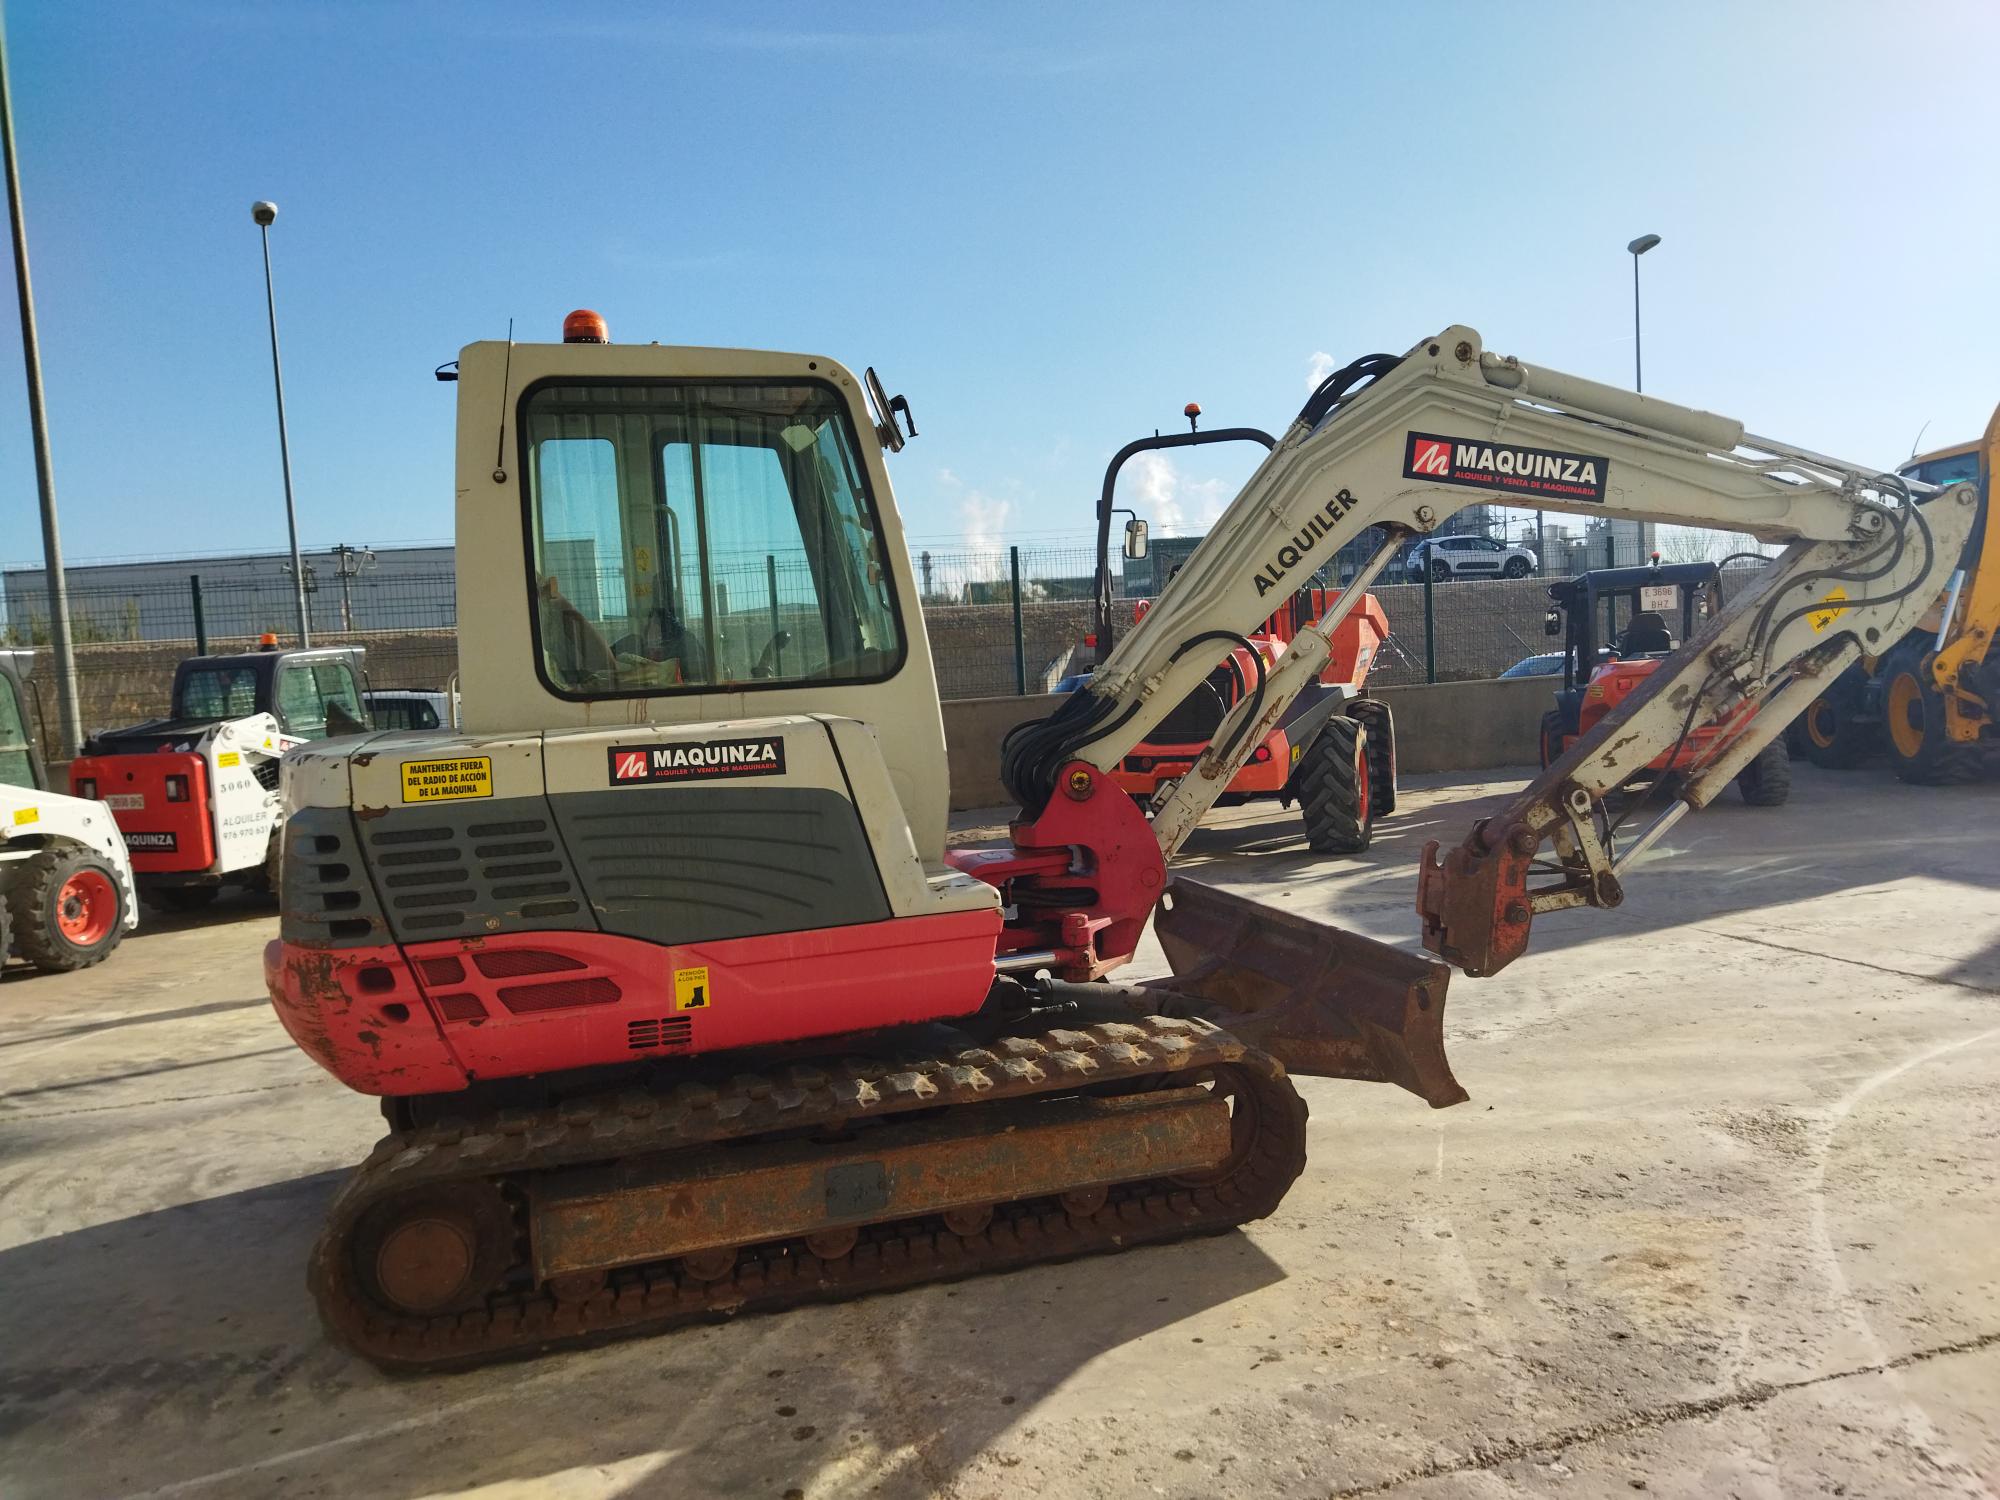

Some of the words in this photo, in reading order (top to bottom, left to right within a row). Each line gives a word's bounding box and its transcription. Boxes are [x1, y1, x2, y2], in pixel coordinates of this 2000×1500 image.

[1456, 445, 1597, 484] MAQUINZA
[1454, 471, 1493, 483] ALQUILER
[1503, 477, 1529, 488] VENTA
[1530, 481, 1541, 489] DE
[1543, 482, 1597, 496] MAQUINARIA
[1253, 488, 1359, 598] ALQUILER
[653, 744, 776, 767] MAQUINZA
[410, 763, 458, 774] MANTENERSE
[460, 761, 483, 770] FUERA
[732, 763, 777, 771] MAQUINARIA
[408, 777, 421, 786] DEL
[423, 775, 447, 785] RADIO
[449, 774, 458, 783] DE
[419, 788, 428, 797] DE
[431, 787, 440, 796] LA
[223, 811, 268, 826] ALQUILER
[124, 834, 174, 846] AQUINZA
